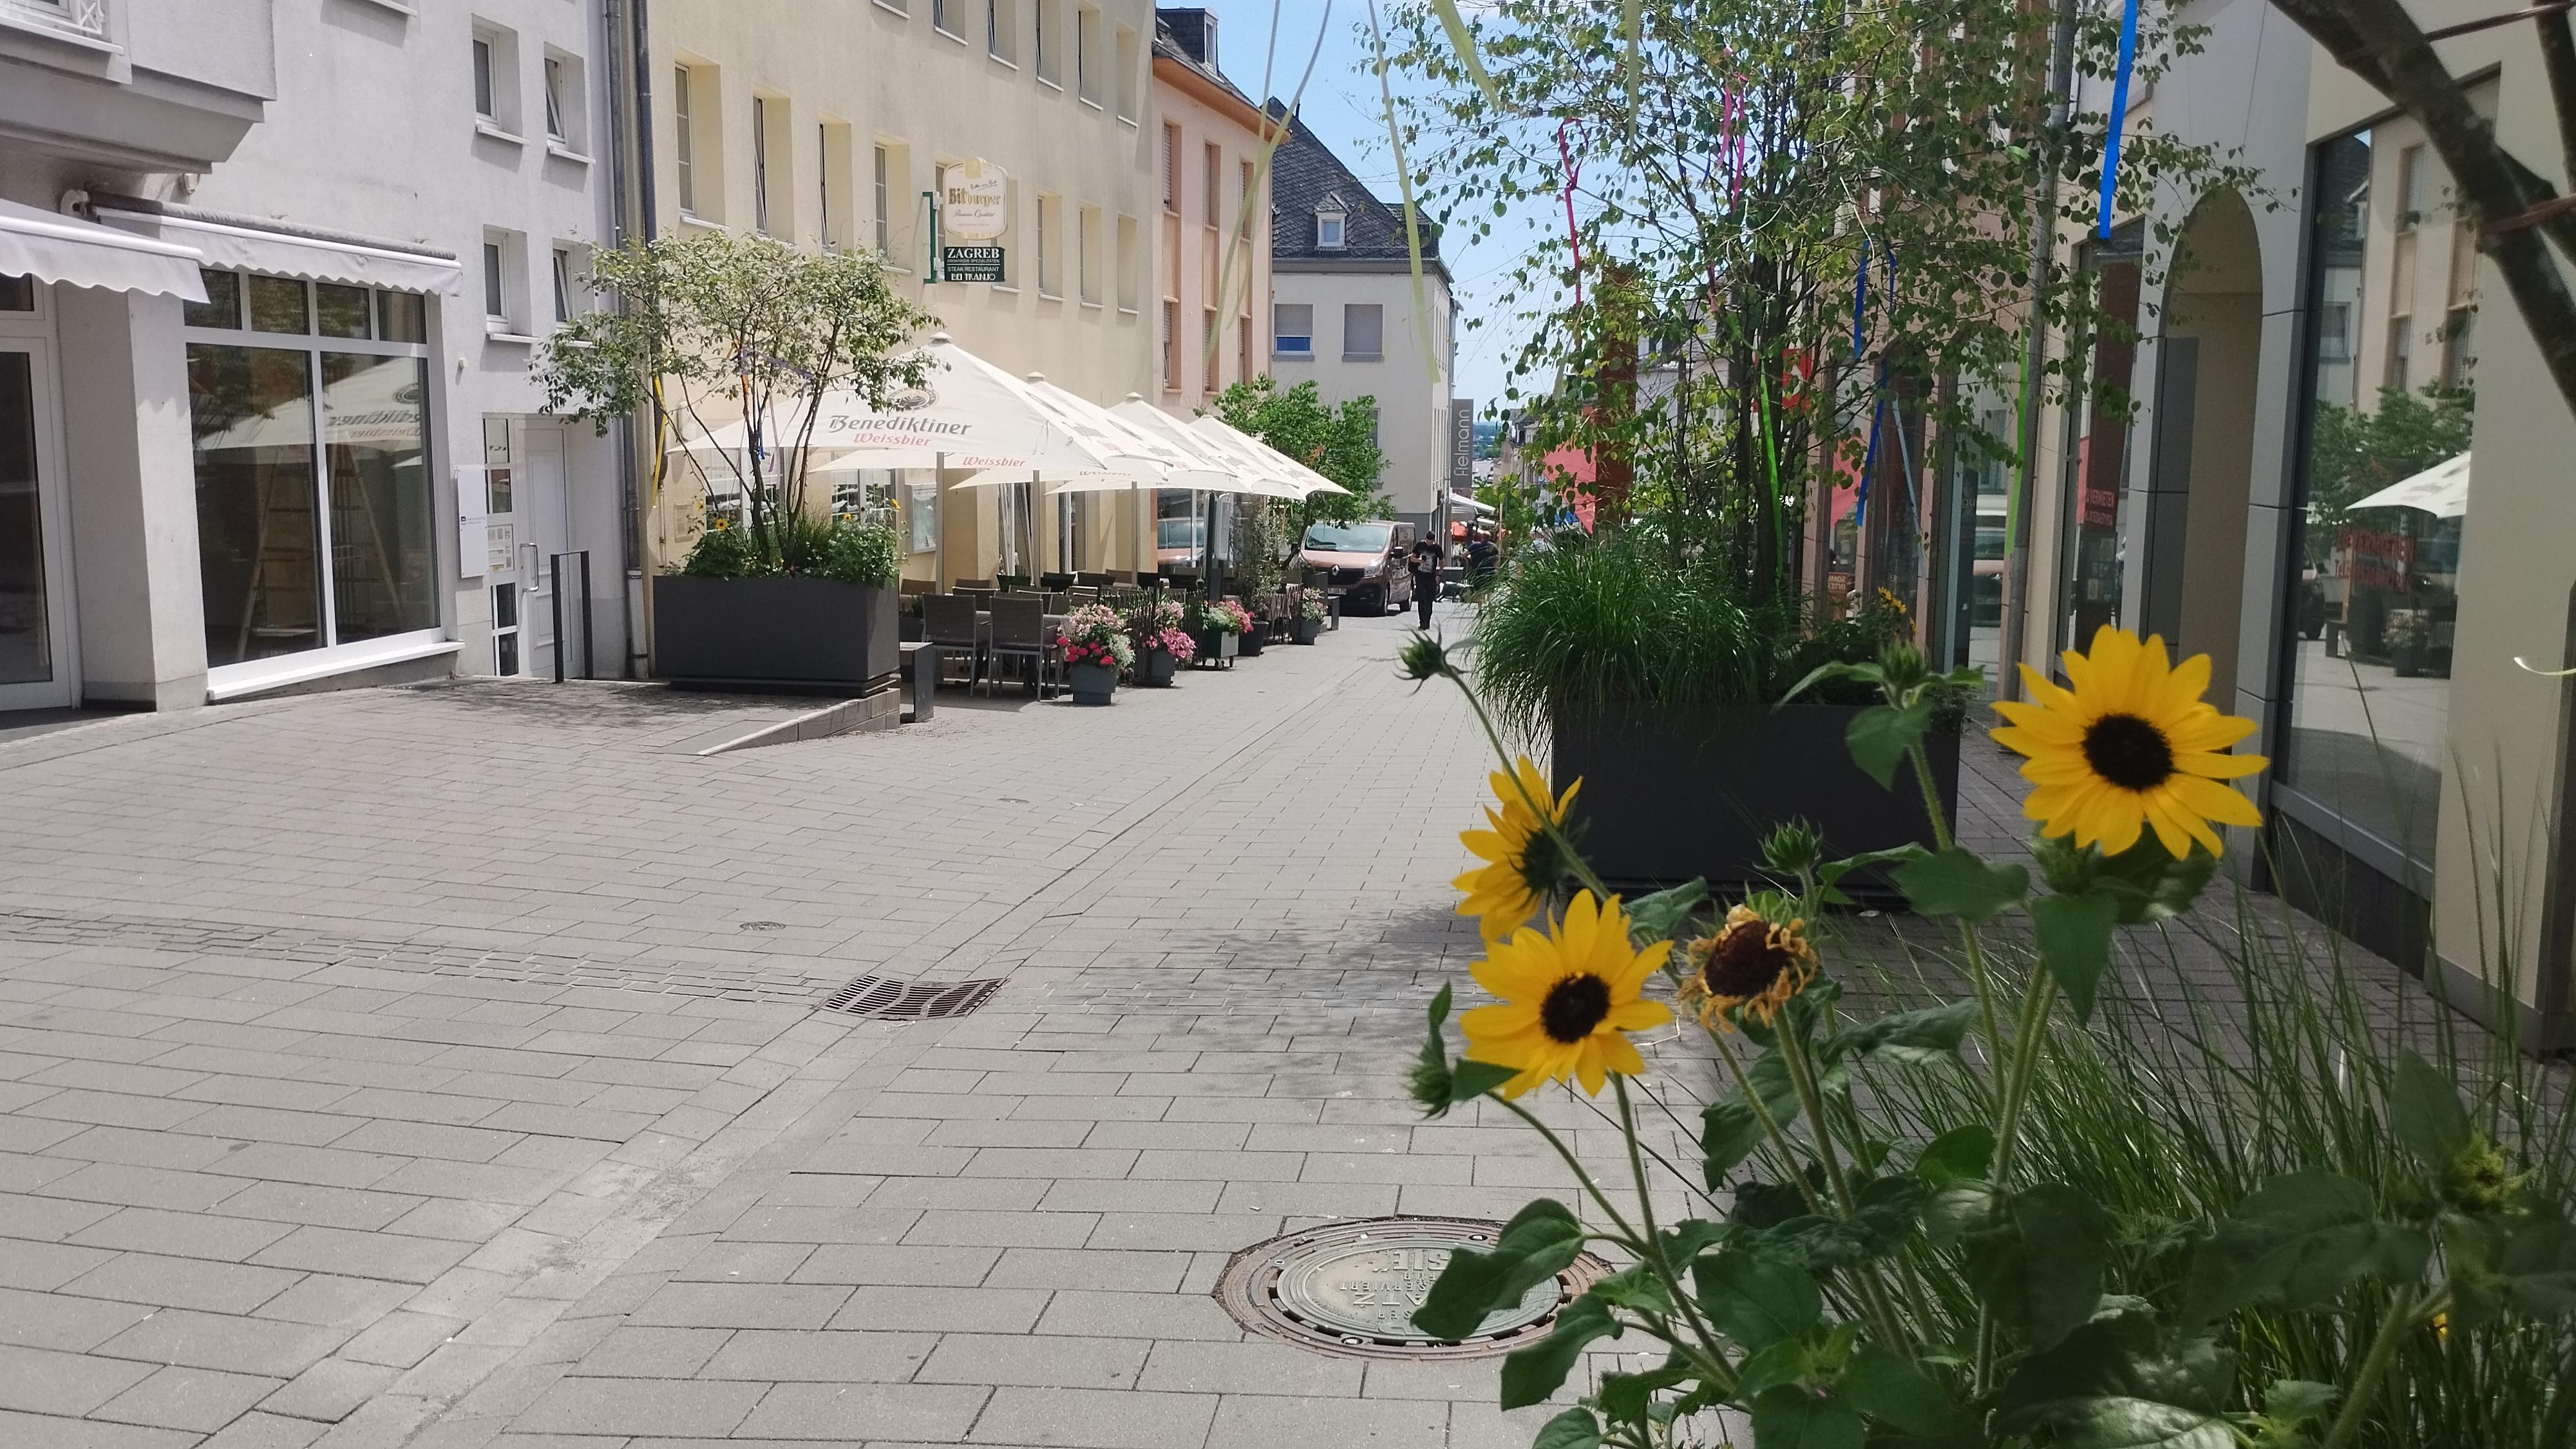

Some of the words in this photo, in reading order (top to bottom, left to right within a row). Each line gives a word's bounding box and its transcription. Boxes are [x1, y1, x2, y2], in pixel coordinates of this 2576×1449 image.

[948, 187, 1001, 207] Bitburger
[947, 248, 999, 258] ZAGREB
[828, 415, 972, 435] Benediktiner
[854, 433, 933, 447] Weissbier
[1454, 409, 1470, 477] fielmann
[962, 456, 1026, 467] Weissbier
[1340, 1280, 1427, 1292] SERVIERT
[1353, 1291, 1429, 1307] ATZ
[1378, 1309, 1413, 1320] SER
